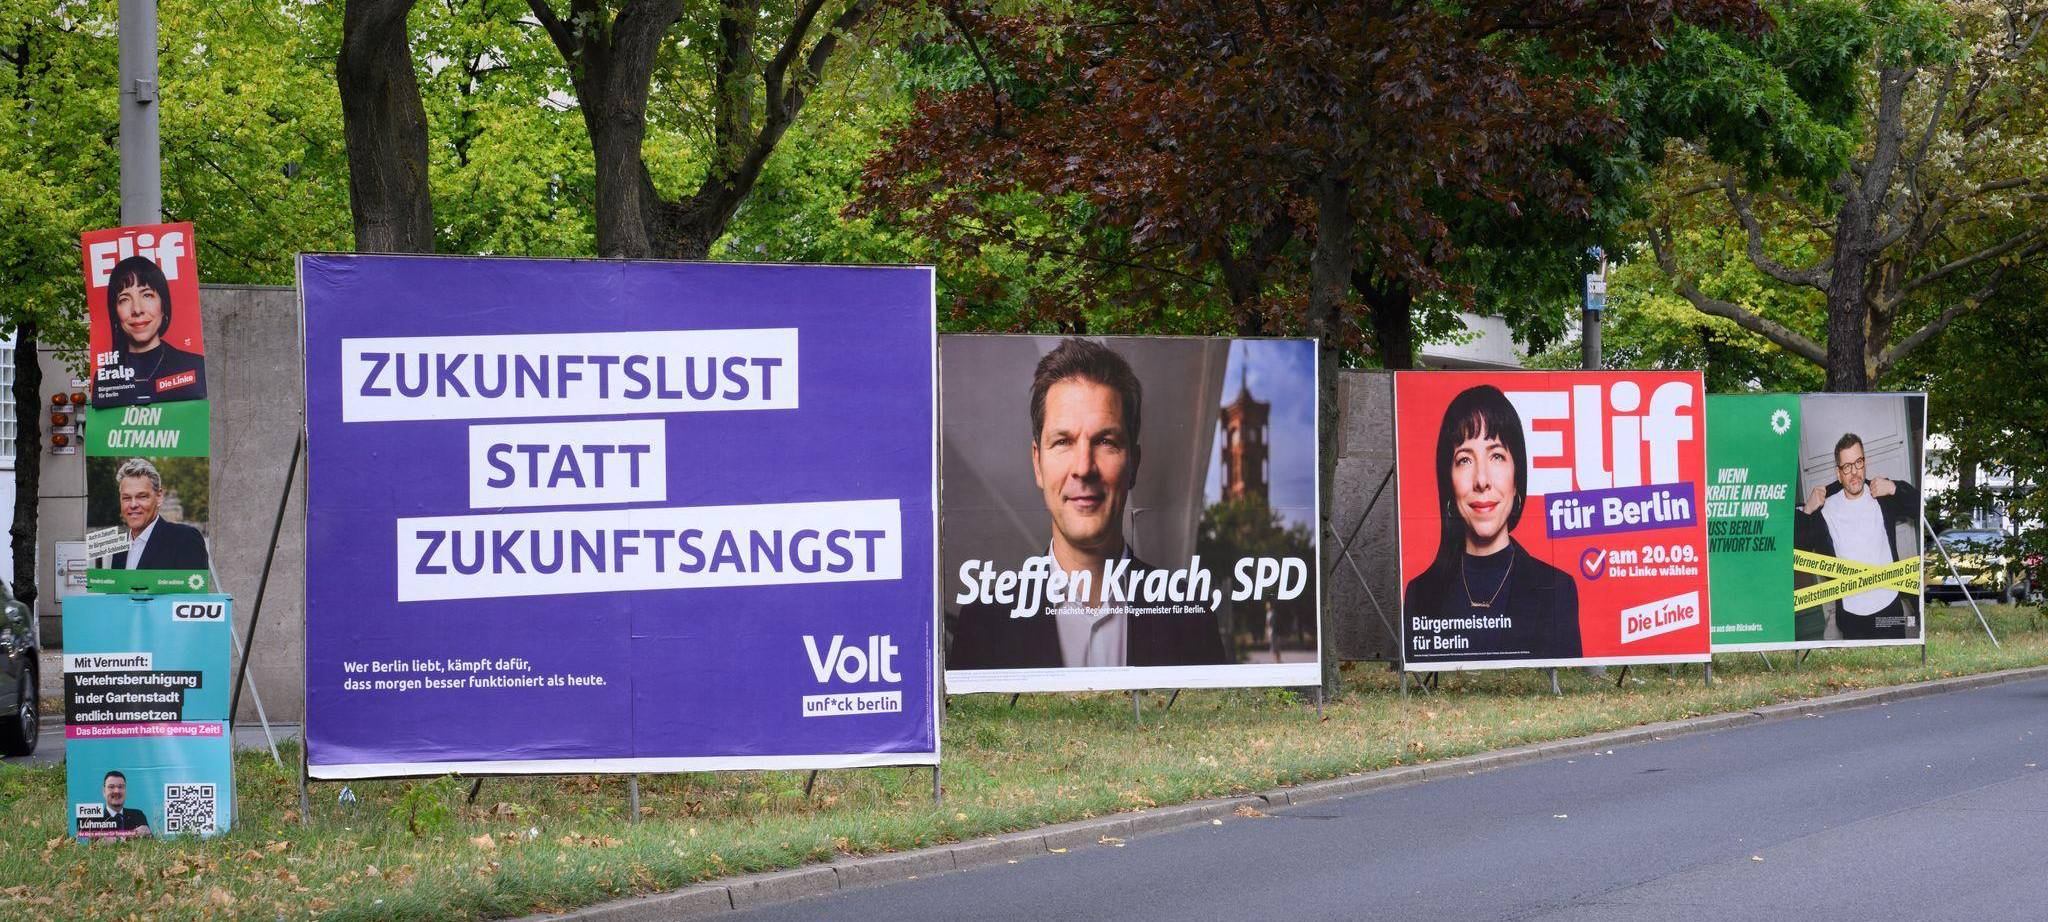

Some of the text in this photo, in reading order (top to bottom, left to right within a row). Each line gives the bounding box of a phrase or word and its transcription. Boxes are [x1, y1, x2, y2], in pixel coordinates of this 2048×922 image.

[89, 231, 185, 288] Elif
[97, 351, 120, 366] Elif
[97, 365, 135, 381] Eralp
[359, 351, 783, 401] ZUKUNFTSLUST
[159, 375, 194, 389] Die Linke
[121, 405, 162, 426] JÖRN
[107, 429, 180, 448] OLTMANN
[1503, 380, 1694, 497] Elif
[486, 443, 651, 489] STATT
[1718, 467, 1749, 484] WENN
[1741, 484, 1754, 500] IN
[1754, 484, 1788, 500] FRAGE
[1550, 490, 1691, 531] für Berlin
[1740, 501, 1770, 519] WIRD,
[1729, 519, 1765, 536] BERLIN
[415, 528, 886, 575] ZUKUNFTSANGST
[1752, 535, 1777, 552] SEIN.
[1609, 544, 1699, 565] am 20.09.
[1609, 563, 1699, 577] Die Linke wählen
[1794, 554, 1863, 576] Werner Graf Werne
[956, 555, 1308, 619] Steffen Krach, SPD
[1794, 585, 1839, 607] Zweitstimme
[1840, 580, 1857, 593] Grün
[1858, 567, 1904, 588] Zweitstimme
[175, 604, 222, 619] CDU
[1045, 605, 1206, 617] Der nächste Regierende Bürgermeister für Berlin.
[1627, 604, 1695, 635] Die Linke
[1412, 614, 1512, 634] Bürgermeisterin
[1413, 634, 1470, 651] für Berlin
[74, 656, 148, 668] Mit Vernunft:
[344, 658, 532, 674] Wer Berlin liebt, kämpft dafür,
[802, 635, 902, 683] Volt
[75, 673, 197, 688] Verkehrsberuhigung
[343, 674, 607, 692] dass morgen besser funktioniert als heute.
[75, 691, 180, 704] in der Gartenstadt
[857, 696, 898, 711] berlin
[75, 710, 178, 722] endlich umsetzen
[76, 725, 220, 736] Das Bezirksamt hatte genug Zeit!
[79, 806, 102, 815] Frank
